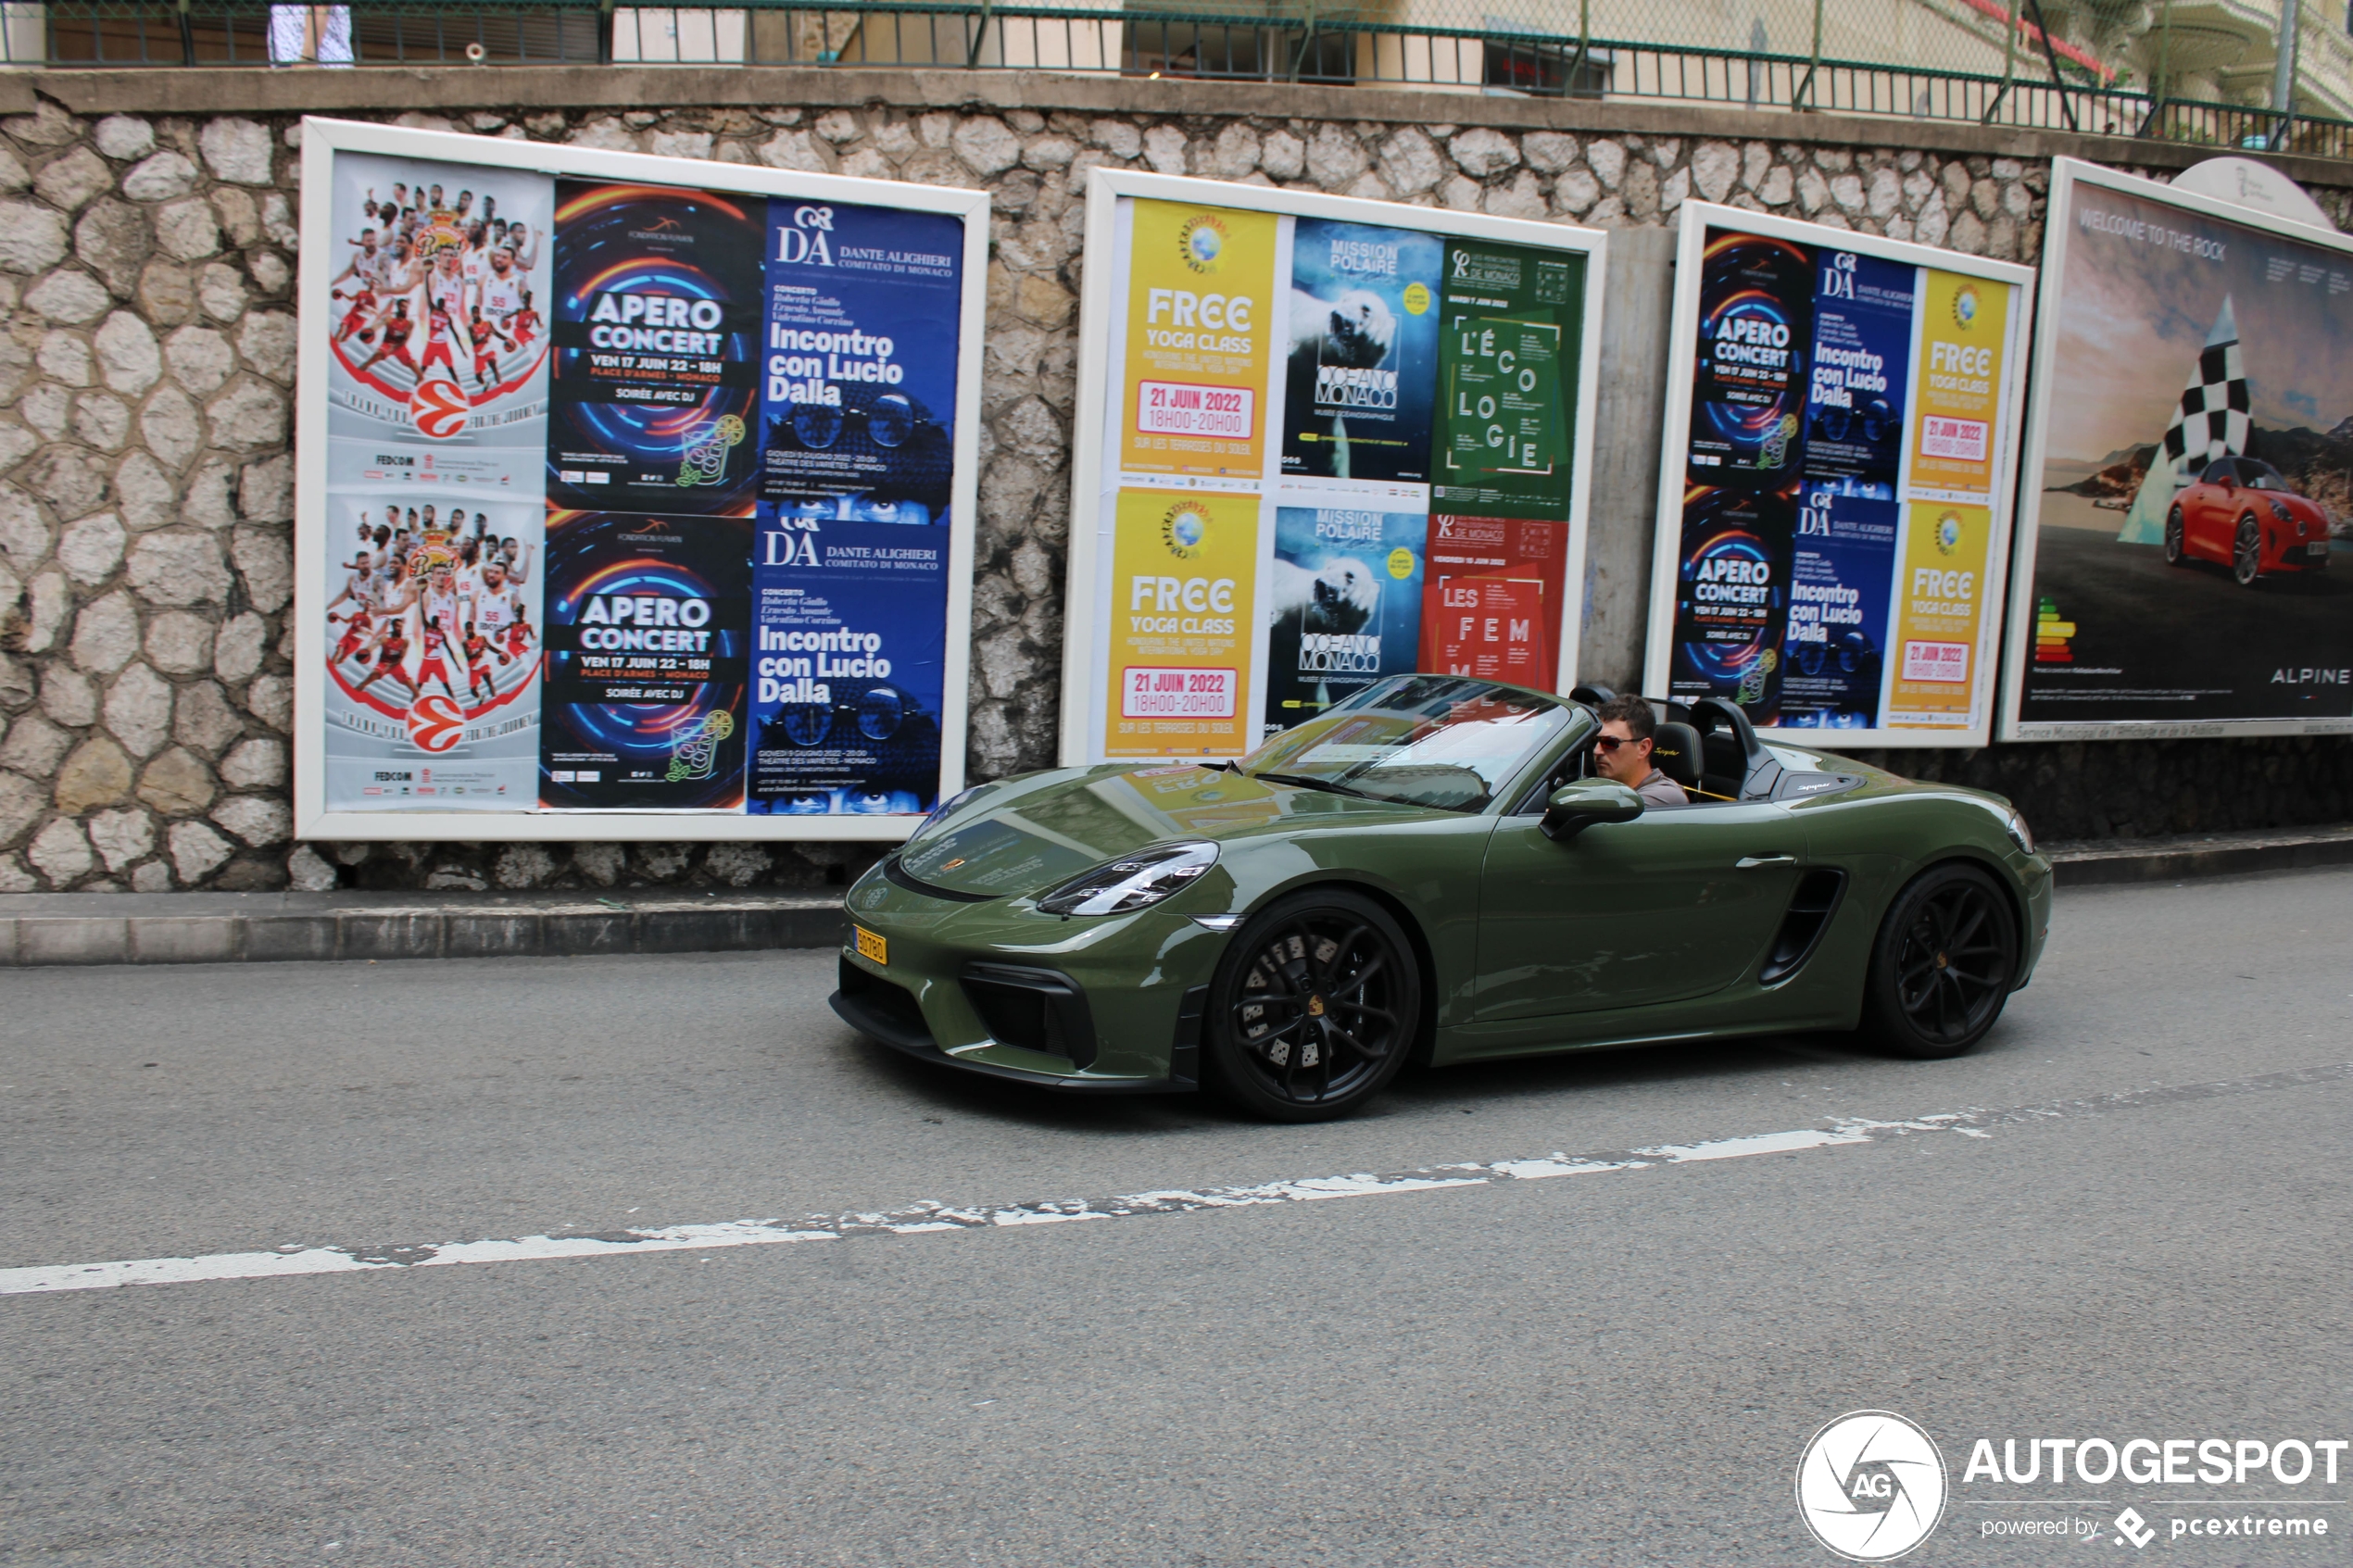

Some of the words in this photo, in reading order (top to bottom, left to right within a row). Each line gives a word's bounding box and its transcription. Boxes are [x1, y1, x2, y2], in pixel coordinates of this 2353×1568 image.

[2080, 207, 2145, 241] WELCOME
[2147, 224, 2165, 245] TO
[2168, 230, 2192, 253] THE
[2194, 237, 2226, 261] ROCK
[775, 227, 836, 266] DA
[839, 246, 884, 261] DANTE
[888, 251, 951, 267] ALIGHIERI
[1331, 240, 1398, 259] MISSION
[838, 259, 891, 271] COMITATO
[894, 264, 905, 272] DI
[908, 266, 952, 277] MONACO
[1330, 255, 1397, 275] POLAIRE
[1470, 268, 1481, 278] DE
[1484, 270, 1520, 282] MONACO
[774, 285, 817, 295] CONCERTO
[1821, 267, 1855, 300] DA
[492, 296, 505, 307] 55
[1147, 288, 1253, 332] FREE
[590, 294, 722, 331] APERO
[589, 325, 723, 356] CONCERT
[771, 322, 894, 358] Incontro
[1146, 329, 1195, 348] YOGA
[1198, 334, 1252, 354] CLASS
[1716, 317, 1790, 348] APERO
[590, 355, 619, 368] VEN
[622, 357, 635, 368] 17
[636, 358, 668, 370] JUIN
[671, 361, 687, 370] 22
[699, 362, 722, 373] 18H
[1715, 342, 1789, 368] CONCERT
[1815, 341, 1883, 370] Incontro
[1930, 341, 1992, 377] FREE
[590, 368, 622, 376] PLACE
[624, 370, 667, 380] D'ARMES
[676, 373, 721, 383] MONACO
[769, 355, 822, 378] con
[828, 353, 903, 384] Lucio
[1317, 365, 1399, 390] OCEANO
[1813, 367, 1843, 385] con
[1845, 367, 1887, 392] Lucio
[1929, 373, 1957, 390] YOGA
[1958, 378, 1990, 394] CLASS
[615, 387, 652, 400] SOIRÉE
[653, 390, 680, 401] AVEC
[682, 393, 695, 402] DJ
[768, 375, 841, 406] Dalla
[1151, 387, 1166, 407] 21
[1170, 389, 1201, 409] JUIN
[1205, 392, 1241, 412] 2022
[1315, 384, 1398, 409] MONACO
[1811, 383, 1852, 408] Dalla
[1150, 410, 1241, 433] 18H00-20H00
[1929, 420, 1938, 435] 21
[1940, 422, 1957, 438] JUIN
[1960, 424, 1982, 441] 2022
[1134, 436, 1151, 448] SUR
[1153, 438, 1166, 449] LES
[1170, 439, 1213, 453] TERRASSES
[1227, 443, 1252, 455] SOLEIL
[376, 455, 414, 466] FEDCOM
[1316, 509, 1384, 526] MISSION
[1798, 507, 1831, 536] DA
[1315, 523, 1382, 540] POLAIRE
[1455, 528, 1466, 537] DE
[1469, 530, 1504, 540] MONACO
[762, 531, 822, 567] DA
[826, 546, 871, 558] DANTE
[874, 548, 937, 560] ALIGHIERI
[824, 559, 879, 570] COMITATO
[880, 560, 891, 569] DI
[893, 561, 938, 570] MONACO
[1696, 558, 1769, 584] APERO
[1130, 575, 1236, 613] FREE
[1695, 583, 1768, 604] CONCERT
[1791, 580, 1859, 604] Incontro
[1913, 568, 1973, 599] FREE
[1443, 588, 1478, 608] LES
[485, 611, 498, 621] 55
[580, 596, 711, 628] APERO
[1694, 606, 1710, 615] VEN
[1789, 605, 1819, 621] con
[1820, 603, 1863, 624] Lucio
[1911, 601, 1939, 614] YOGA
[1940, 603, 1971, 617] CLASS
[1130, 616, 1178, 633] YOGA
[1181, 618, 1235, 634] CLASS
[1459, 617, 1475, 641] F
[1484, 619, 1499, 641] E
[1509, 619, 1529, 642] M
[1787, 621, 1828, 643] Dalla
[580, 628, 711, 651] CONCERT
[759, 625, 882, 652] Incontro
[1301, 633, 1381, 654] OCEANO
[581, 656, 609, 668] VEN
[611, 658, 624, 668] 17
[626, 658, 658, 669] JUIN
[659, 659, 677, 670] 22
[688, 659, 711, 670] 18H
[1299, 651, 1379, 672] MONACO
[1910, 646, 1920, 660] 21
[1922, 646, 1939, 661] JUIN
[1942, 647, 1962, 662] 2022
[580, 669, 611, 677] PLACE
[614, 670, 656, 678] D'ARMES
[758, 657, 811, 677] con
[817, 652, 892, 678] Lucio
[1135, 673, 1151, 692] 21
[1154, 673, 1185, 692] JUIN
[1189, 674, 1225, 693] 2022
[2271, 669, 2351, 684] ALPINE
[606, 686, 642, 698] SOIRÉE
[643, 688, 670, 698] AVEC
[671, 689, 685, 699] DJ
[758, 678, 831, 704] Dalla
[1134, 695, 1225, 712] 18H00-20H00
[1118, 722, 1135, 734] SUR
[1138, 722, 1151, 734] LES
[1153, 722, 1195, 734] TERRASSES
[1198, 722, 1209, 734] DU
[1211, 722, 1235, 734] SOLEIL
[2017, 726, 2051, 739] Service
[375, 771, 412, 782] FEDCOM
[1796, 783, 1831, 791] Spyder
